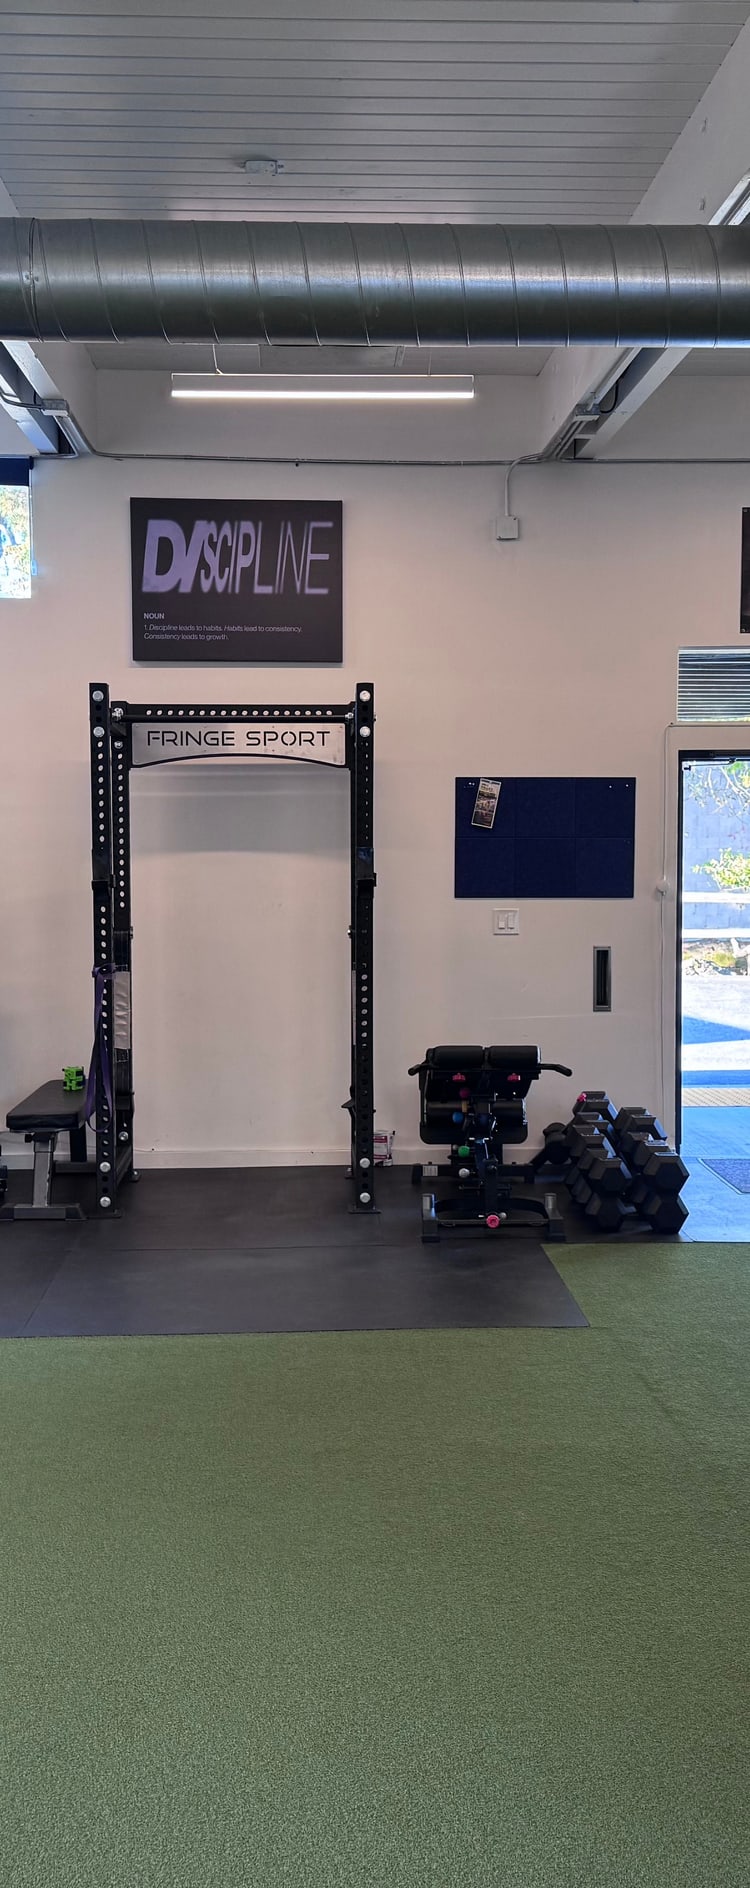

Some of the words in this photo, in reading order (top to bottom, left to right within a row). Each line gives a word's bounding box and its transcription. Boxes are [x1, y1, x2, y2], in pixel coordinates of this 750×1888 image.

[142, 519, 333, 594] DISCIPLINE
[143, 612, 165, 620] NOUN
[149, 624, 178, 632] Discipline
[143, 633, 181, 641] Consistency
[206, 633, 229, 641] growth.
[147, 731, 235, 747] FRINGE
[246, 731, 331, 747] SPORT
